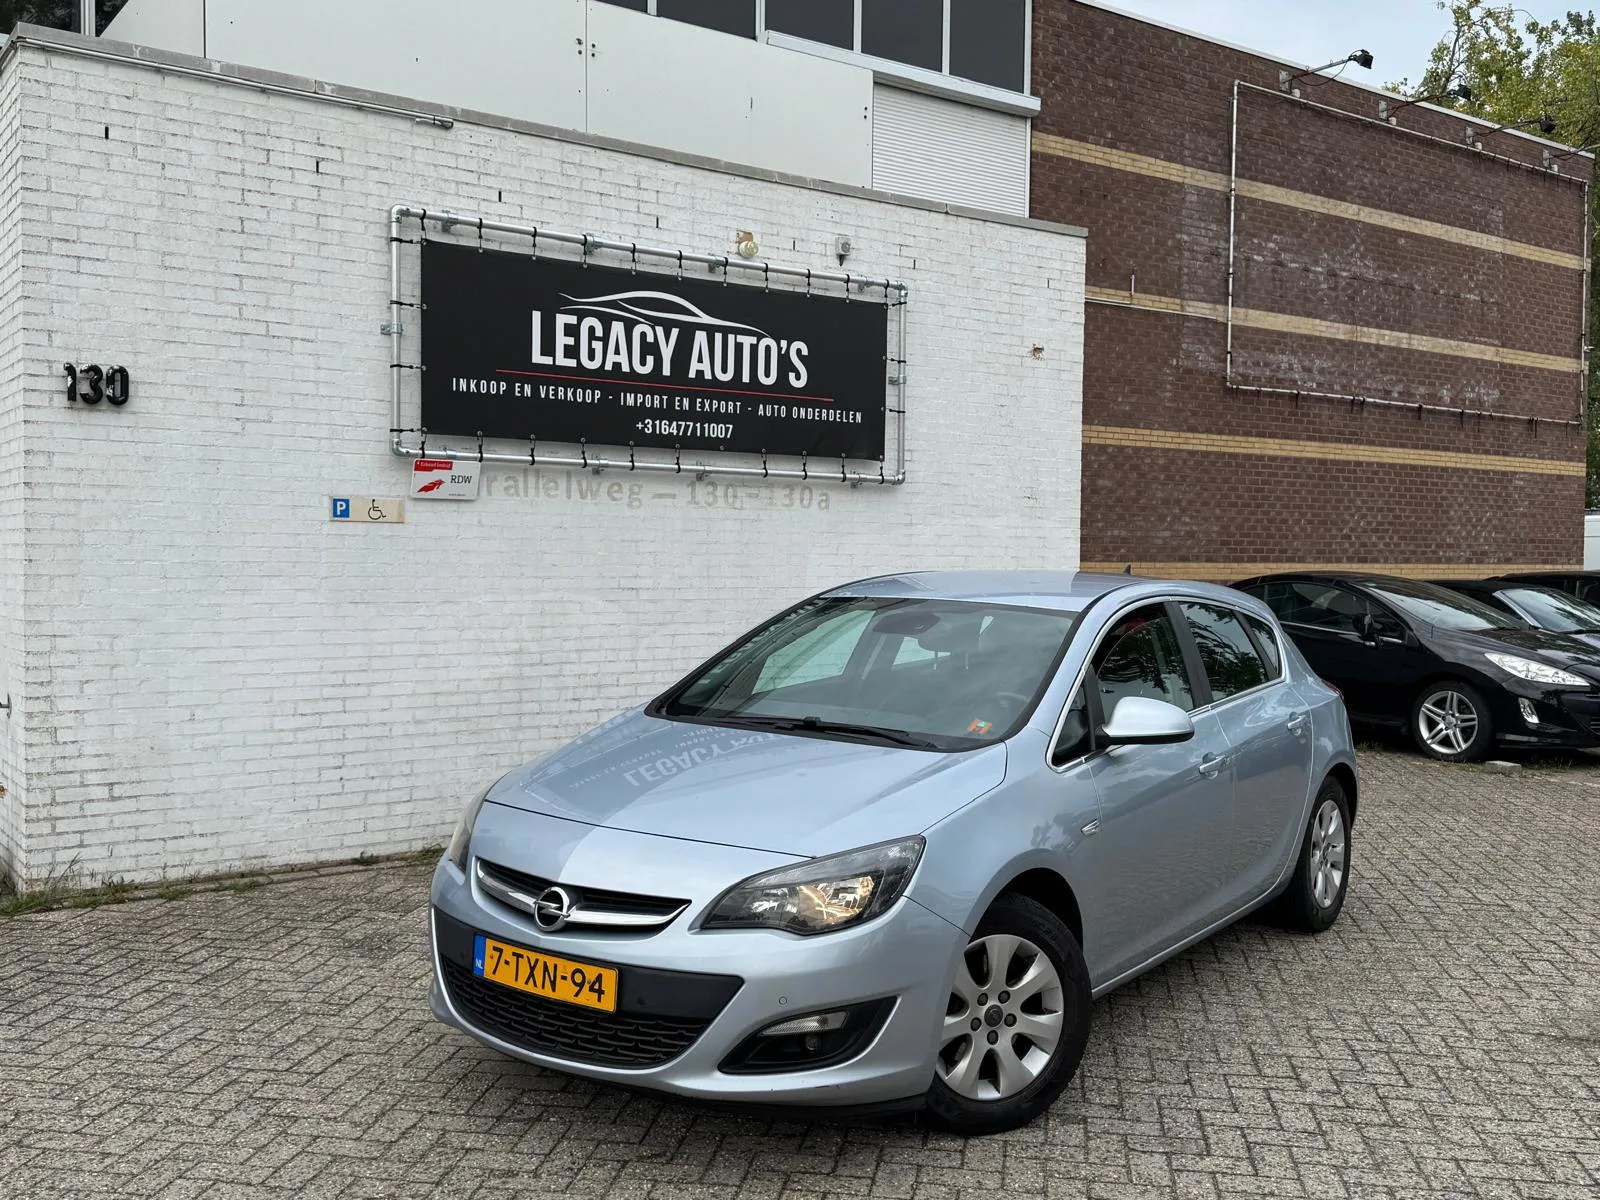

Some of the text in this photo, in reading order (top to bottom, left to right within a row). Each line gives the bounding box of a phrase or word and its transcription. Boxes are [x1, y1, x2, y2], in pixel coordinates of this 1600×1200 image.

[531, 309, 809, 389] LEGACY AUTO'S
[63, 362, 130, 406] 130
[452, 377, 507, 396] INKOOP
[514, 382, 532, 398] EN
[539, 384, 602, 404] VERKOOP
[619, 391, 669, 410] IMPORT
[674, 396, 690, 411] EN
[695, 398, 742, 415] EXPORT
[757, 403, 787, 419] AUTO
[791, 406, 863, 425] ONDERDELEN
[635, 418, 734, 440] +31647711007
[450, 474, 473, 485] RDW
[336, 501, 347, 516] P
[475, 958, 484, 970] NL
[491, 945, 606, 1003] 7-TXN-94
